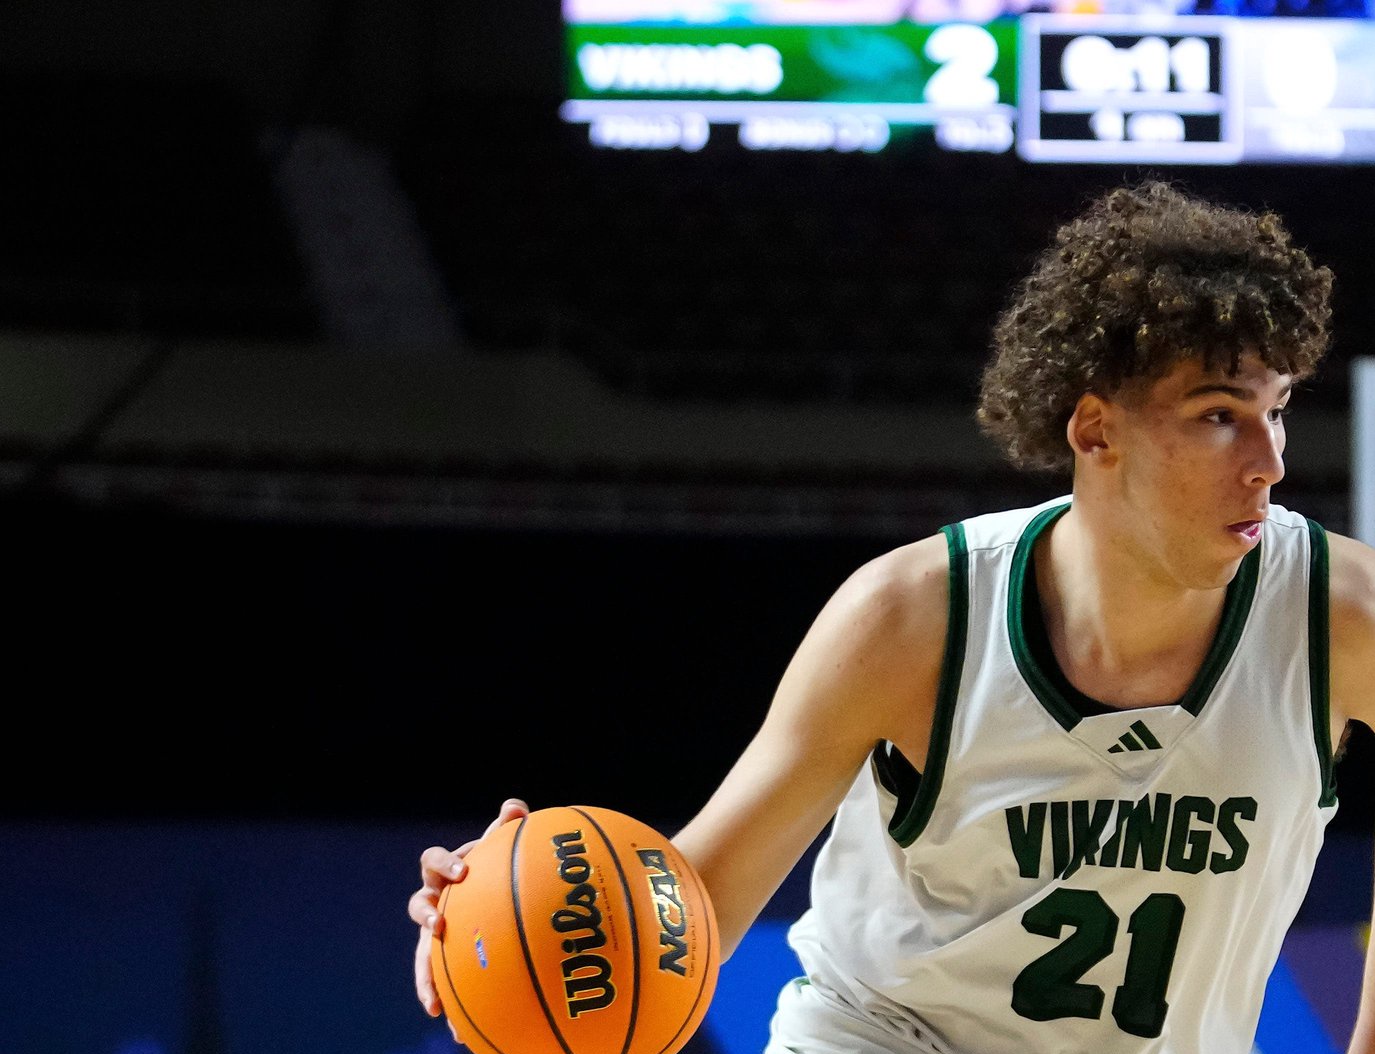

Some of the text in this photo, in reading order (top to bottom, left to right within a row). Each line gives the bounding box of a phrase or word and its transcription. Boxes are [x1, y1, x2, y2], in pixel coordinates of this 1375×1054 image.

[923, 22, 1000, 108] 2
[1005, 793, 1259, 881] VIKINGS
[550, 829, 618, 1020] Wilson
[636, 848, 689, 978] NCAA
[1011, 888, 1186, 1039] 21
